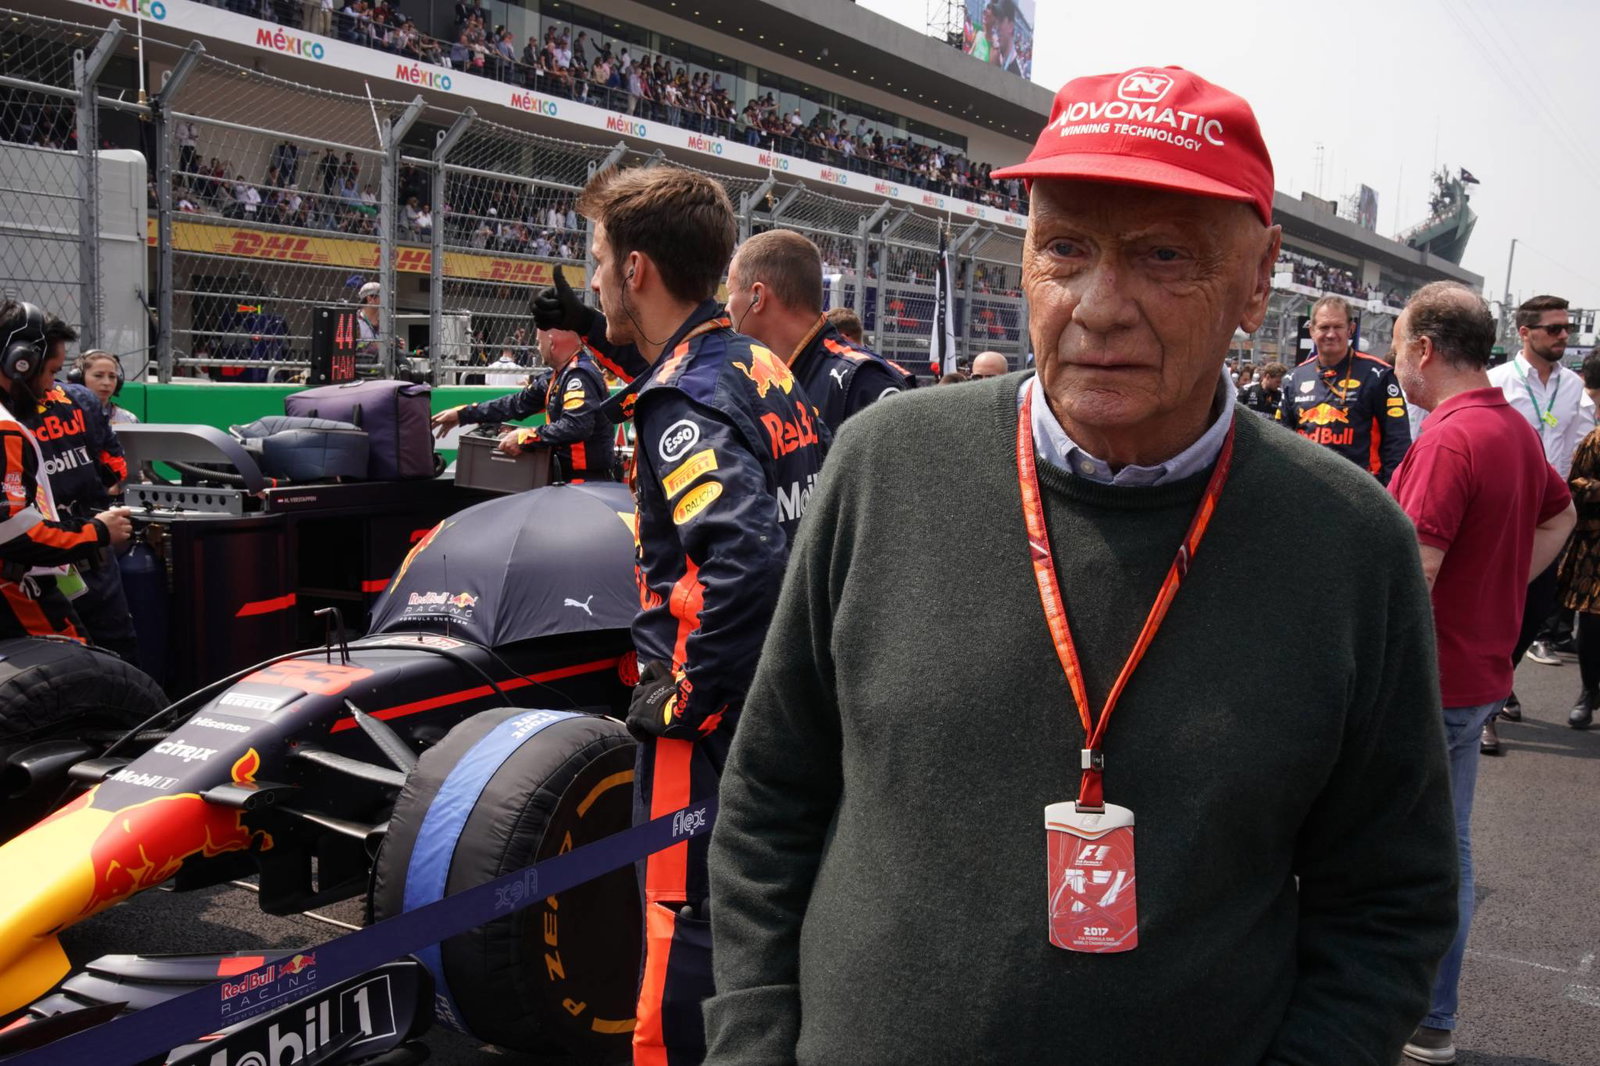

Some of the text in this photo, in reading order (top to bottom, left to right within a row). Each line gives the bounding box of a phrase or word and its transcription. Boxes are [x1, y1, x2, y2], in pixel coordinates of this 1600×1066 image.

[1050, 101, 1225, 146] NOVOMATIC
[1061, 122, 1202, 151] WINNING TECHNOLOGY
[231, 231, 315, 261] DHL
[488, 259, 553, 284] DHL
[335, 313, 353, 349] 44
[44, 449, 77, 475] obil
[668, 455, 711, 492] PIRELLI
[684, 486, 715, 516] RAUCH
[777, 473, 818, 523] Moi
[404, 605, 473, 618] RACING
[190, 717, 251, 733] Hisense
[110, 769, 158, 787] Mobil
[672, 807, 706, 837] flex
[1083, 926, 1109, 936] 2017
[221, 970, 317, 1015] RACING
[191, 1000, 330, 1066] bil
